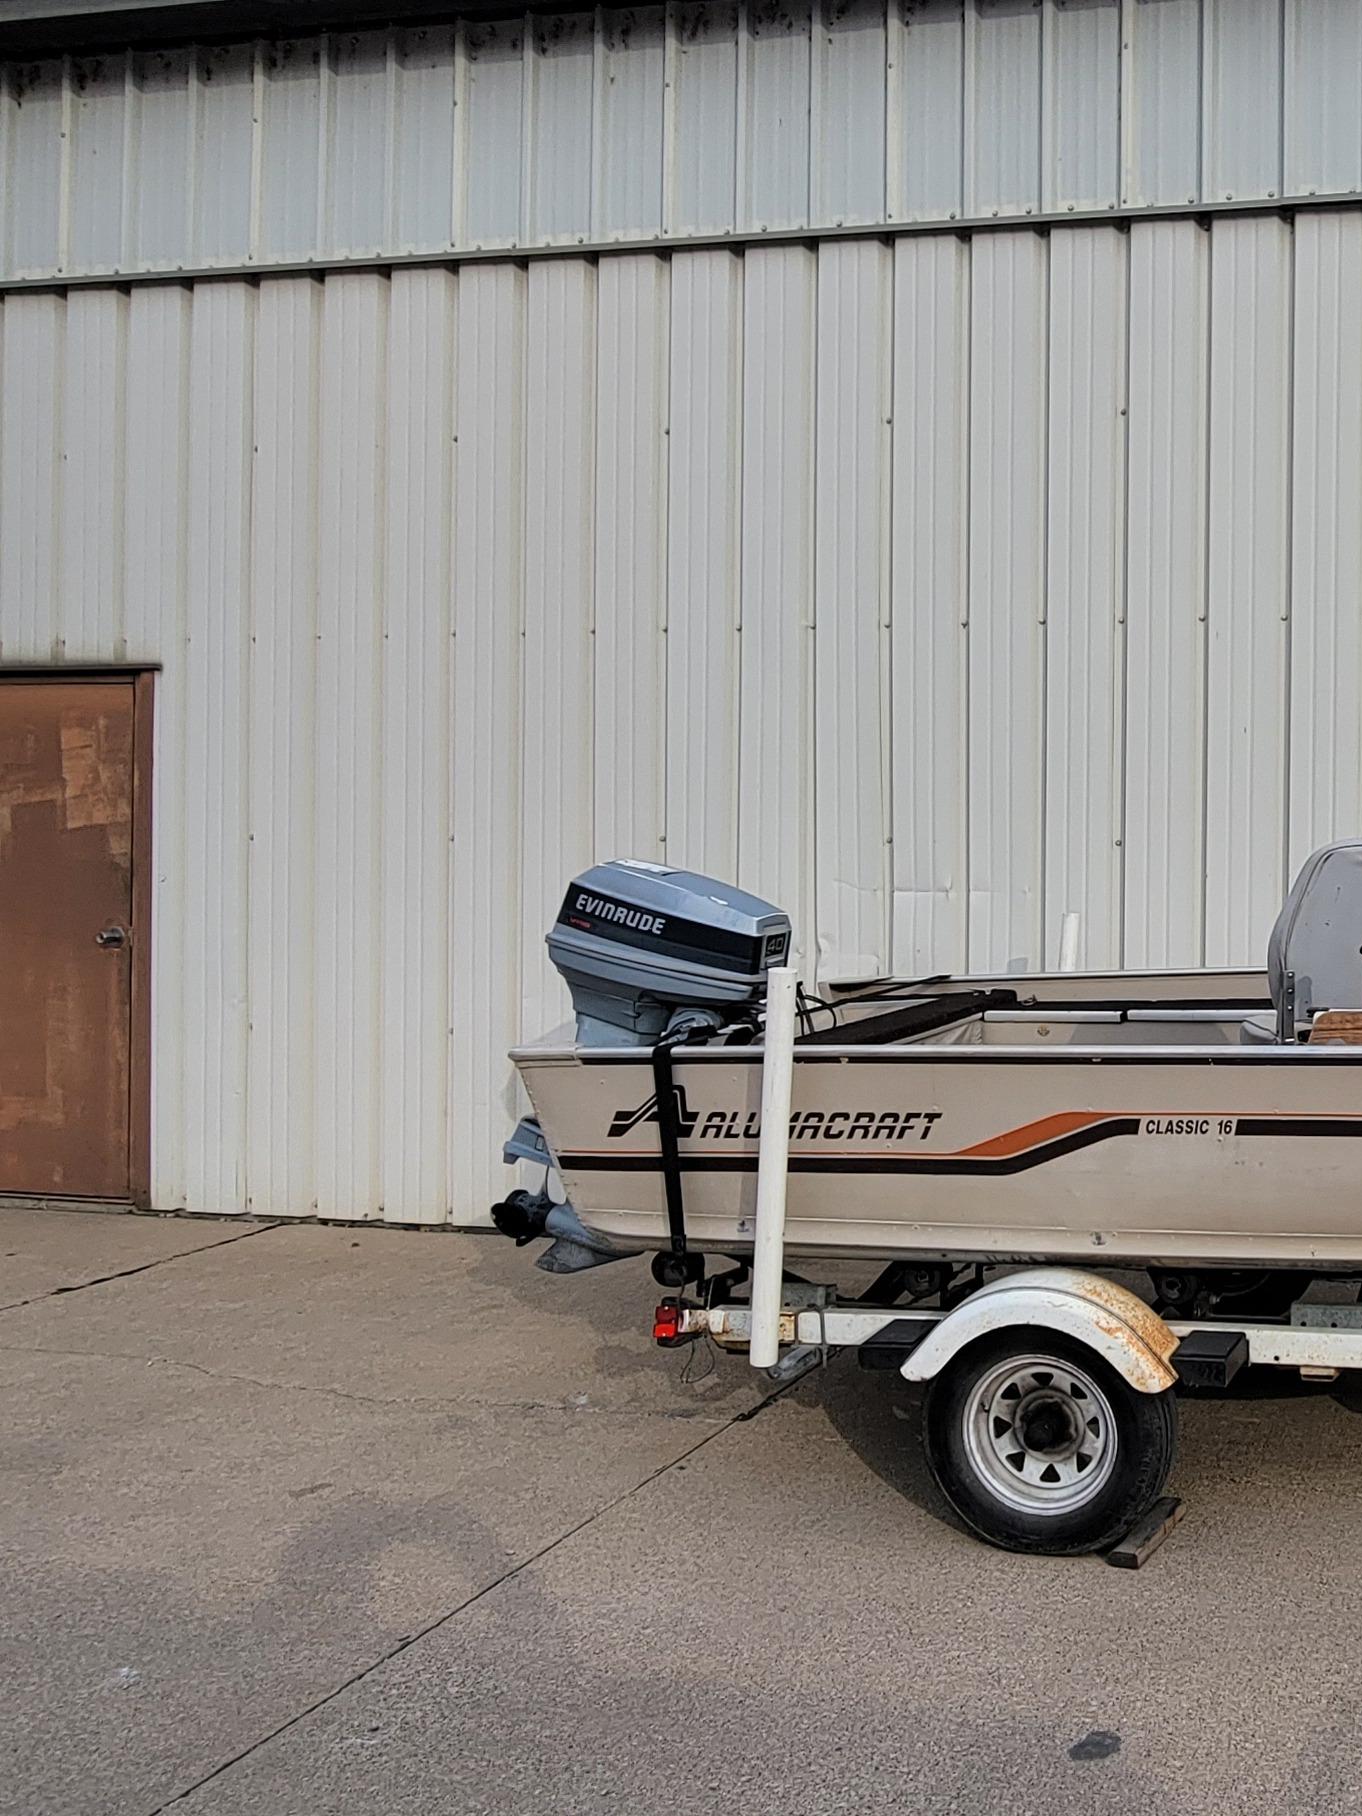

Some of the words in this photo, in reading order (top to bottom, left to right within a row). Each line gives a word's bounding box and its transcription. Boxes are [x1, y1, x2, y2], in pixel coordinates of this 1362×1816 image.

[575, 893, 667, 935] EVINRUDE
[1145, 1119, 1210, 1135] CLASSIC
[1217, 1119, 1234, 1135] 16
